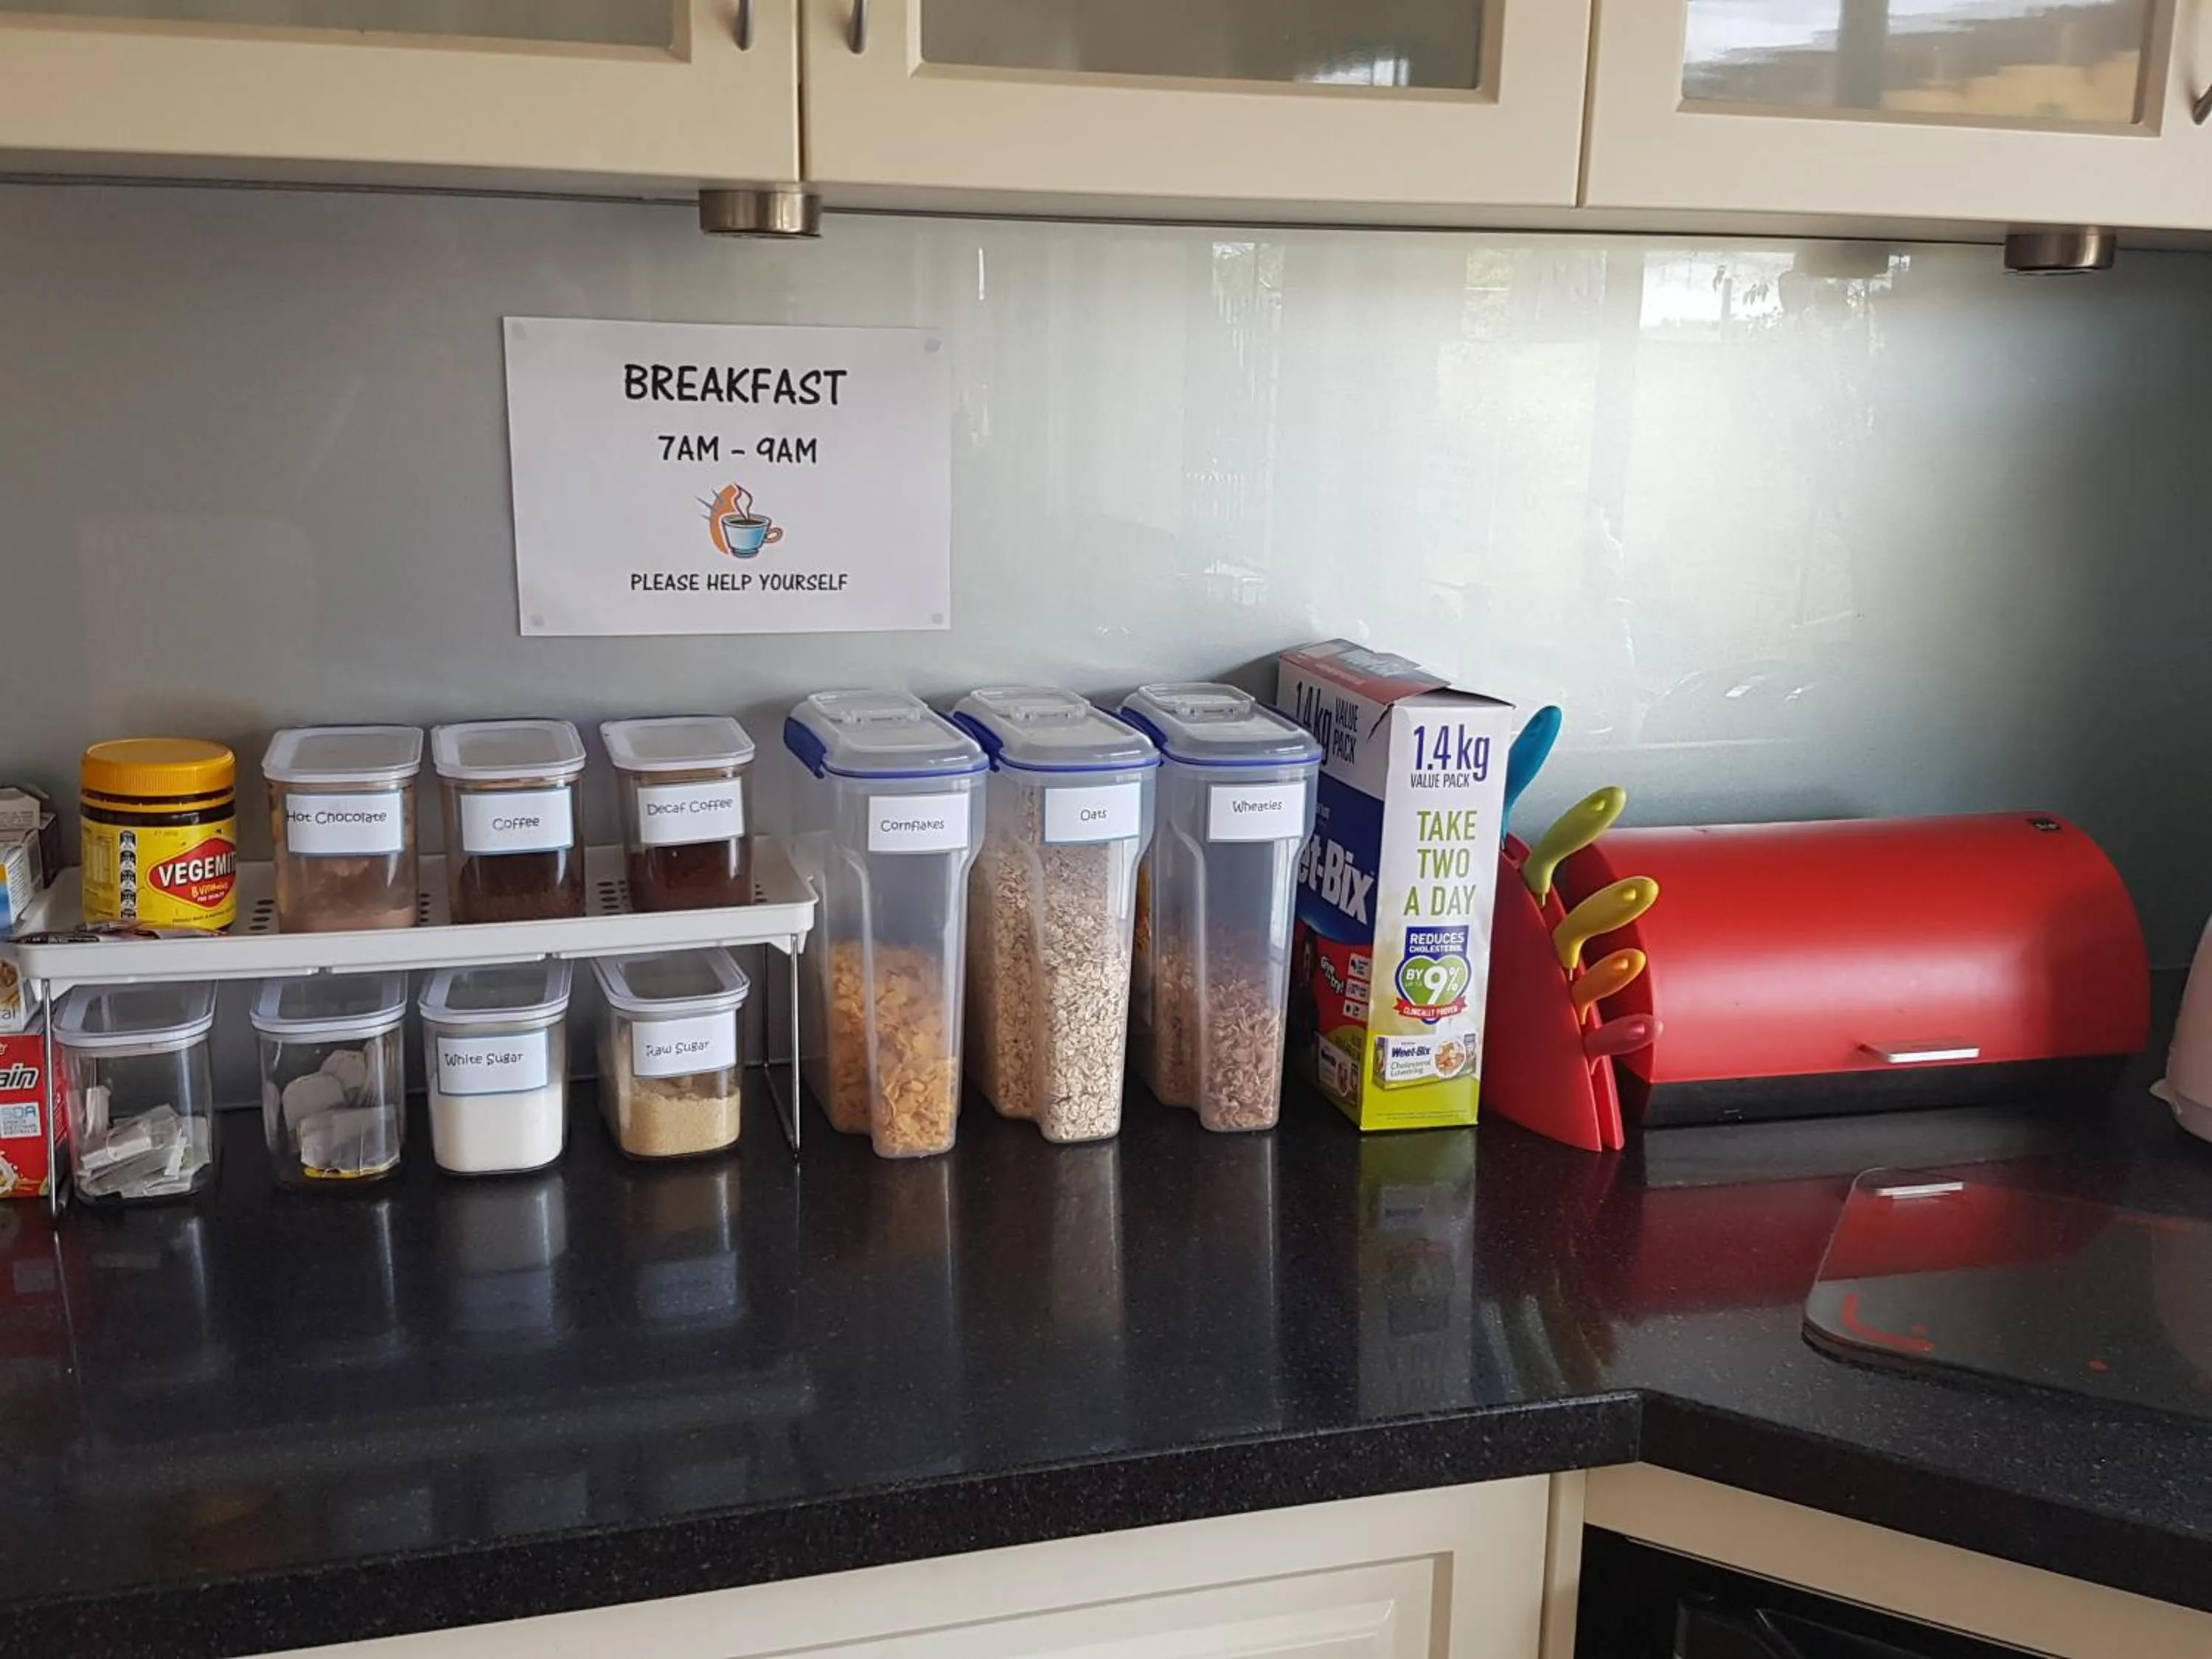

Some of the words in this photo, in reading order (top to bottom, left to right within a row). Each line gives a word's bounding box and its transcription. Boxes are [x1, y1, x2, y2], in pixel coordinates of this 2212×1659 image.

[624, 364, 847, 406] BREAKFAST
[658, 435, 720, 462] 7AM
[757, 437, 817, 465] 9AM
[630, 573, 700, 591] PLEASE
[706, 574, 753, 591] HELP
[759, 574, 849, 591] YOURSELF
[1335, 696, 1359, 732] VALUE
[1332, 728, 1357, 765] PACK
[1411, 772, 1440, 788] VALUE
[1443, 771, 1470, 788] PACK
[647, 801, 686, 815] Decaf
[689, 799, 733, 813] Coffee
[1232, 798, 1283, 814] Wheaties
[286, 810, 311, 823] Hot
[315, 811, 387, 825] Chocolate
[1079, 808, 1107, 821] Oats
[492, 815, 540, 831] Coffee
[880, 818, 945, 833] Cornflakes
[1416, 810, 1478, 841] TAKE
[1416, 848, 1470, 879] TWO
[1403, 886, 1420, 917] A
[1430, 884, 1478, 916] DAY
[1410, 932, 1465, 945] REDUCES
[1409, 945, 1464, 953] CHOLESTEROL
[1406, 968, 1423, 980] BY
[0, 1007, 15, 1020] al
[675, 1041, 710, 1055] Sugar
[444, 1052, 483, 1067] White
[486, 1051, 524, 1066] Sugar
